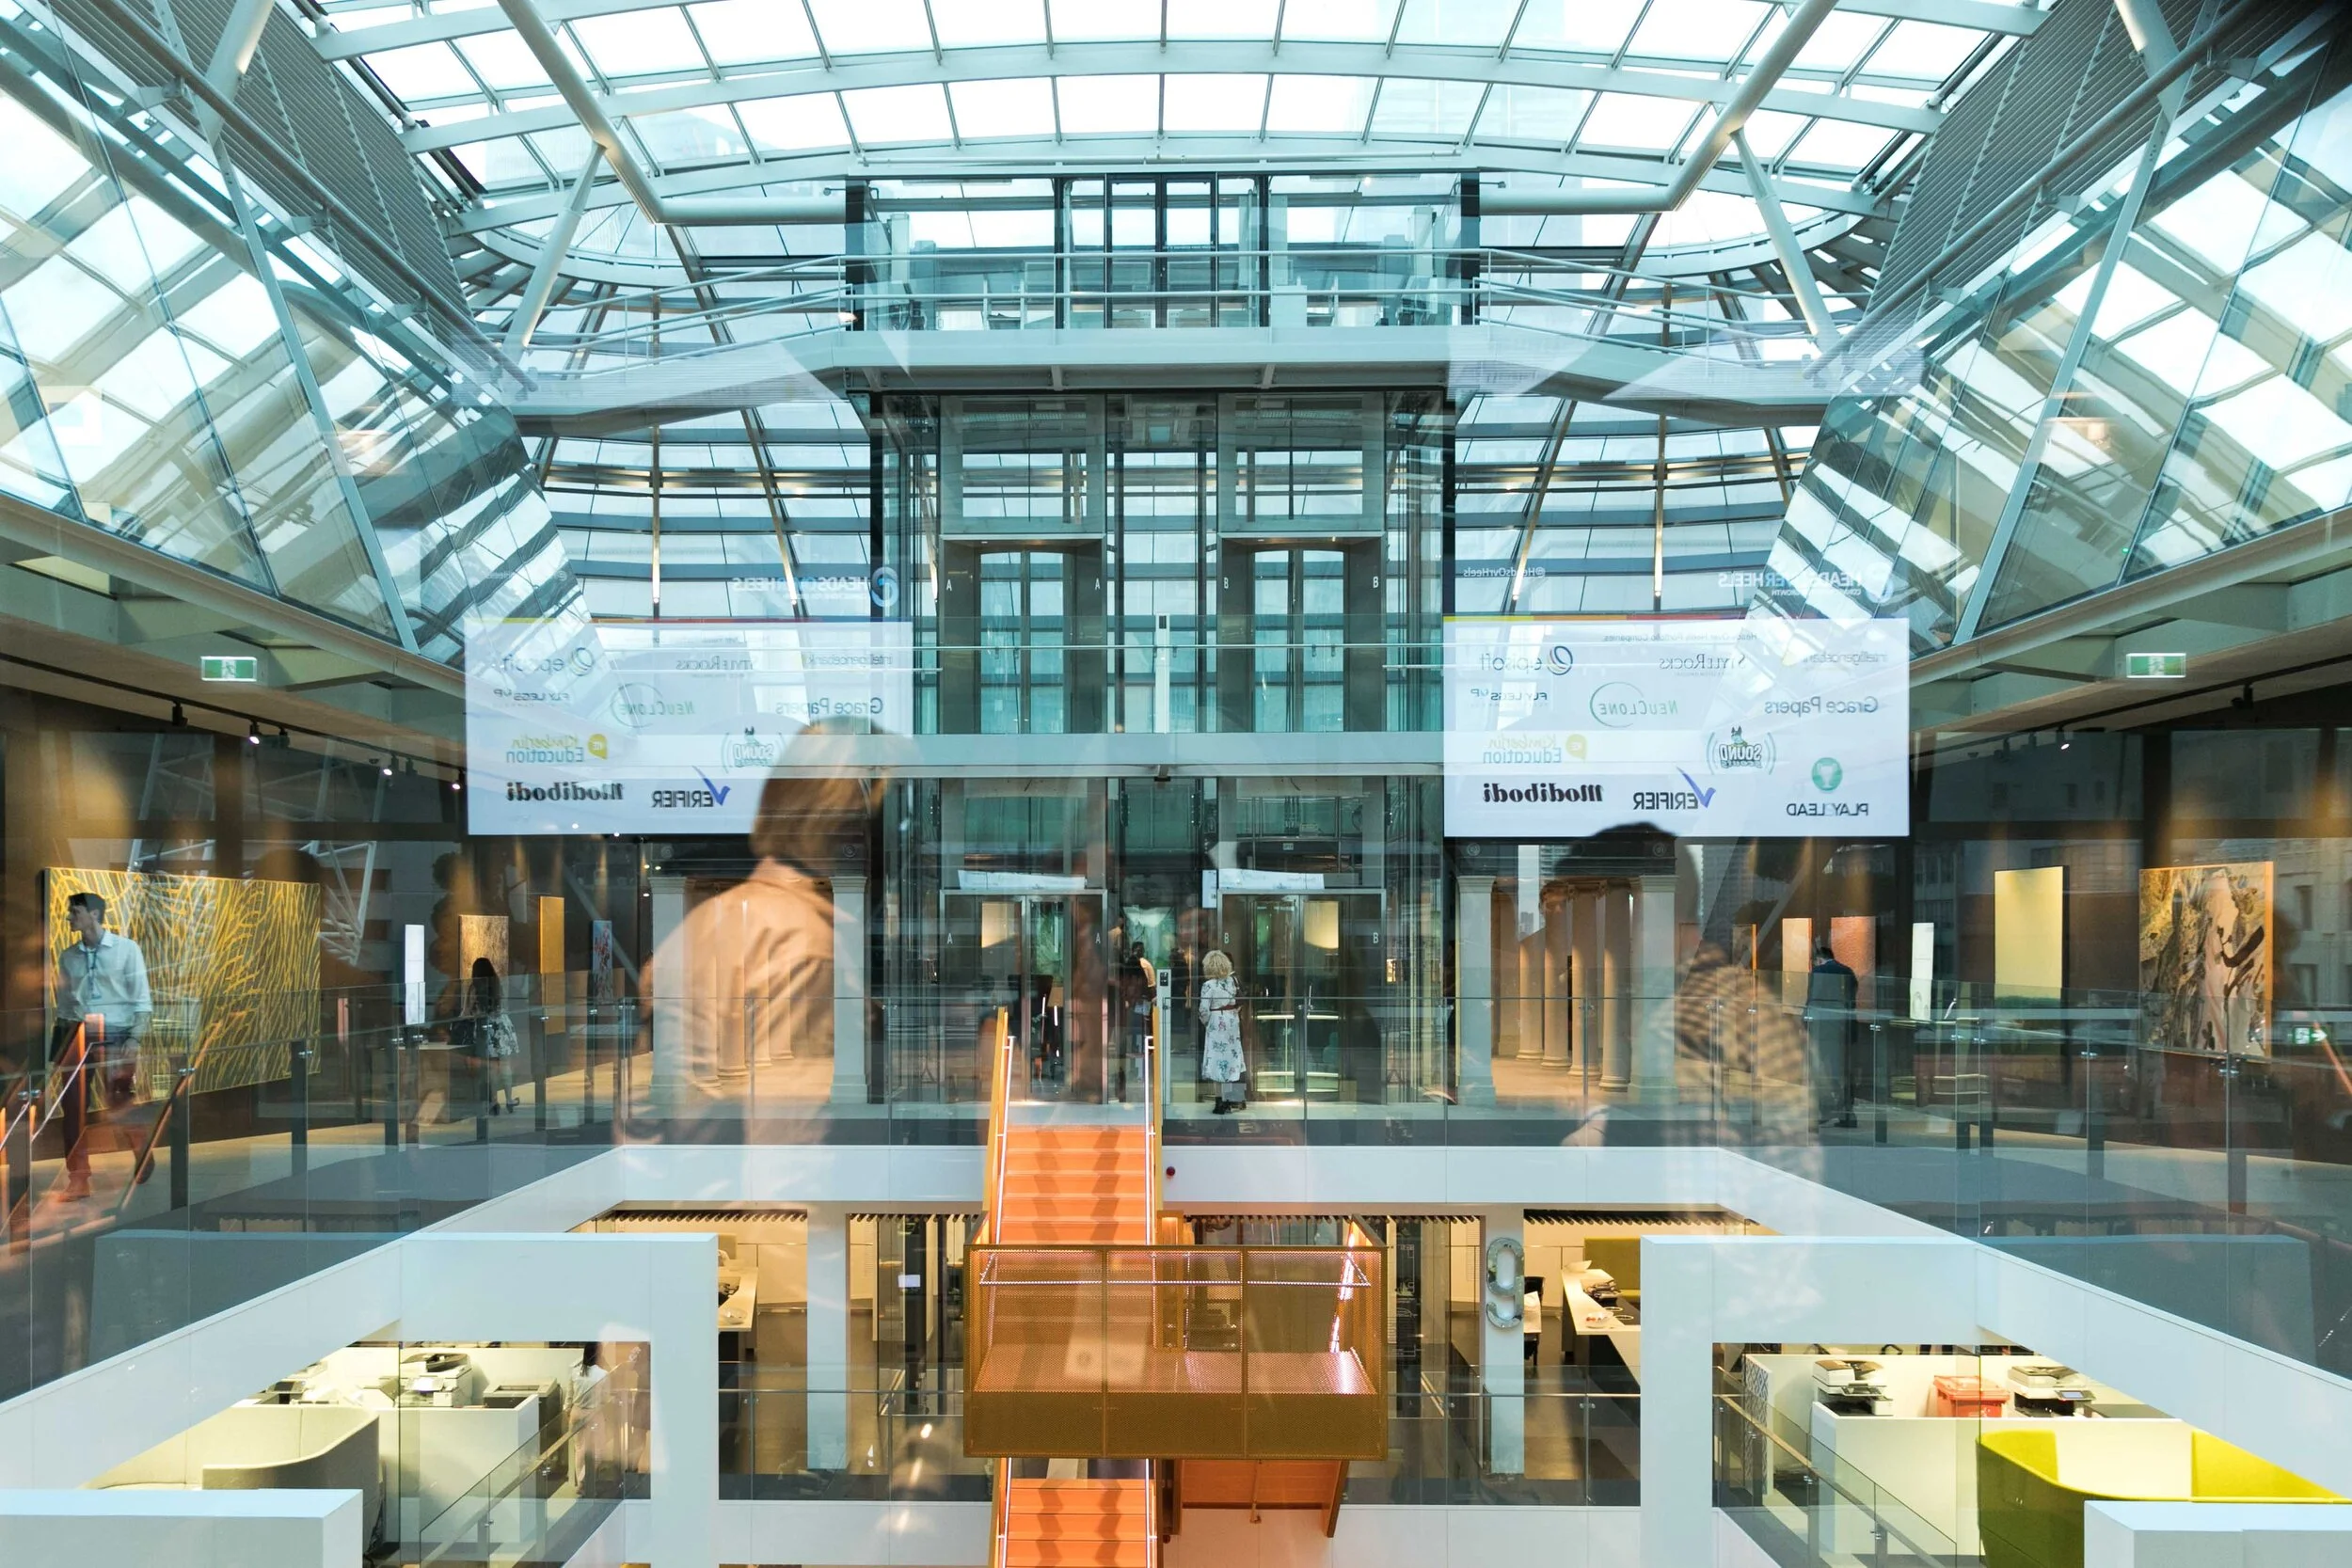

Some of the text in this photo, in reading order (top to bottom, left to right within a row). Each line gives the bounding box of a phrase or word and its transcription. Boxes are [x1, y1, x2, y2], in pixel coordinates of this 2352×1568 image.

[946, 579, 952, 591] A
[1095, 578, 1101, 590] A
[1224, 577, 1229, 589] B
[1373, 576, 1379, 588] B
[946, 933, 953, 944] A
[1095, 932, 1102, 944] A
[1224, 932, 1230, 944] B
[1373, 932, 1379, 944] B
[1486, 1237, 1525, 1329] 9
